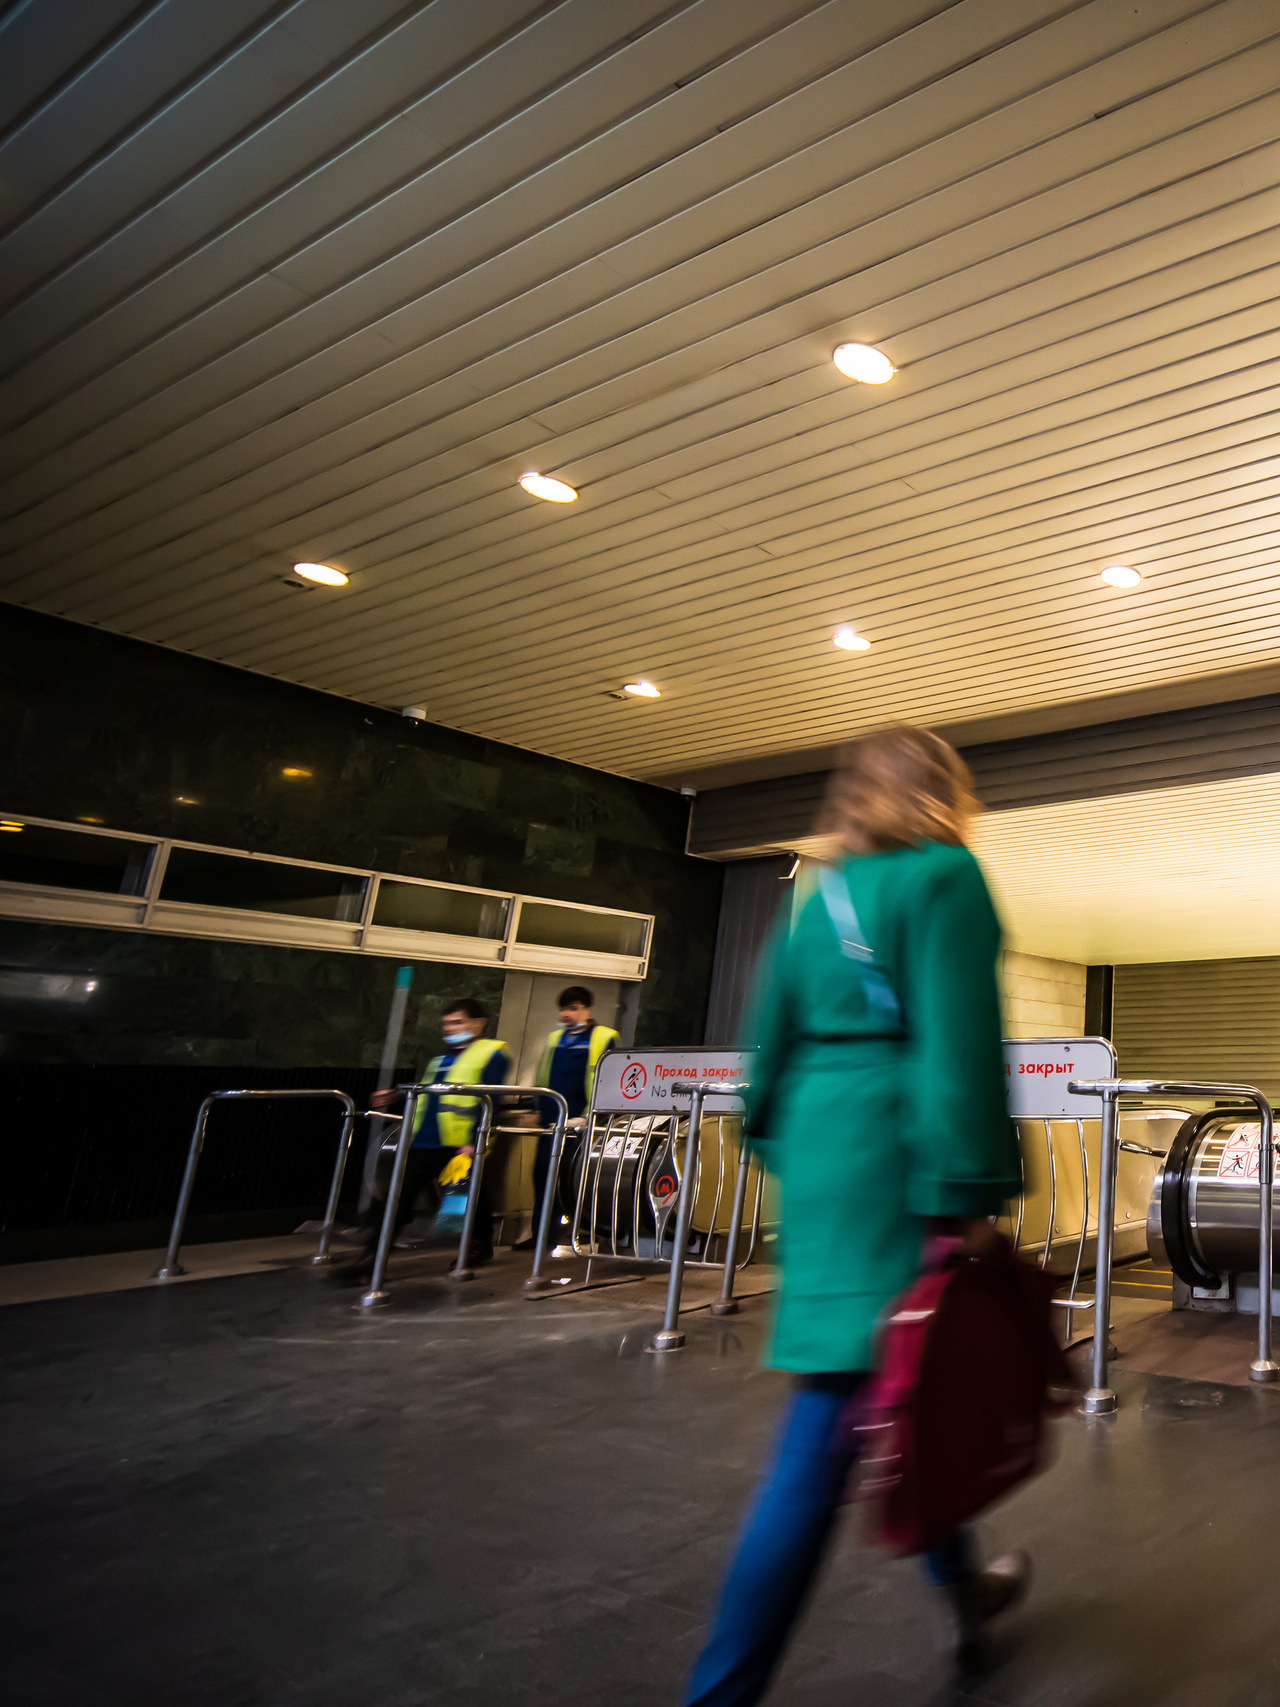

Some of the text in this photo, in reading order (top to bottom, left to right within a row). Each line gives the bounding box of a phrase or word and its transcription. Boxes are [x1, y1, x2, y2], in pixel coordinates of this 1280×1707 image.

[654, 1064, 745, 1081] Проход закрыт
[1018, 1063, 1075, 1079] закрыт
[651, 1085, 667, 1098] No
